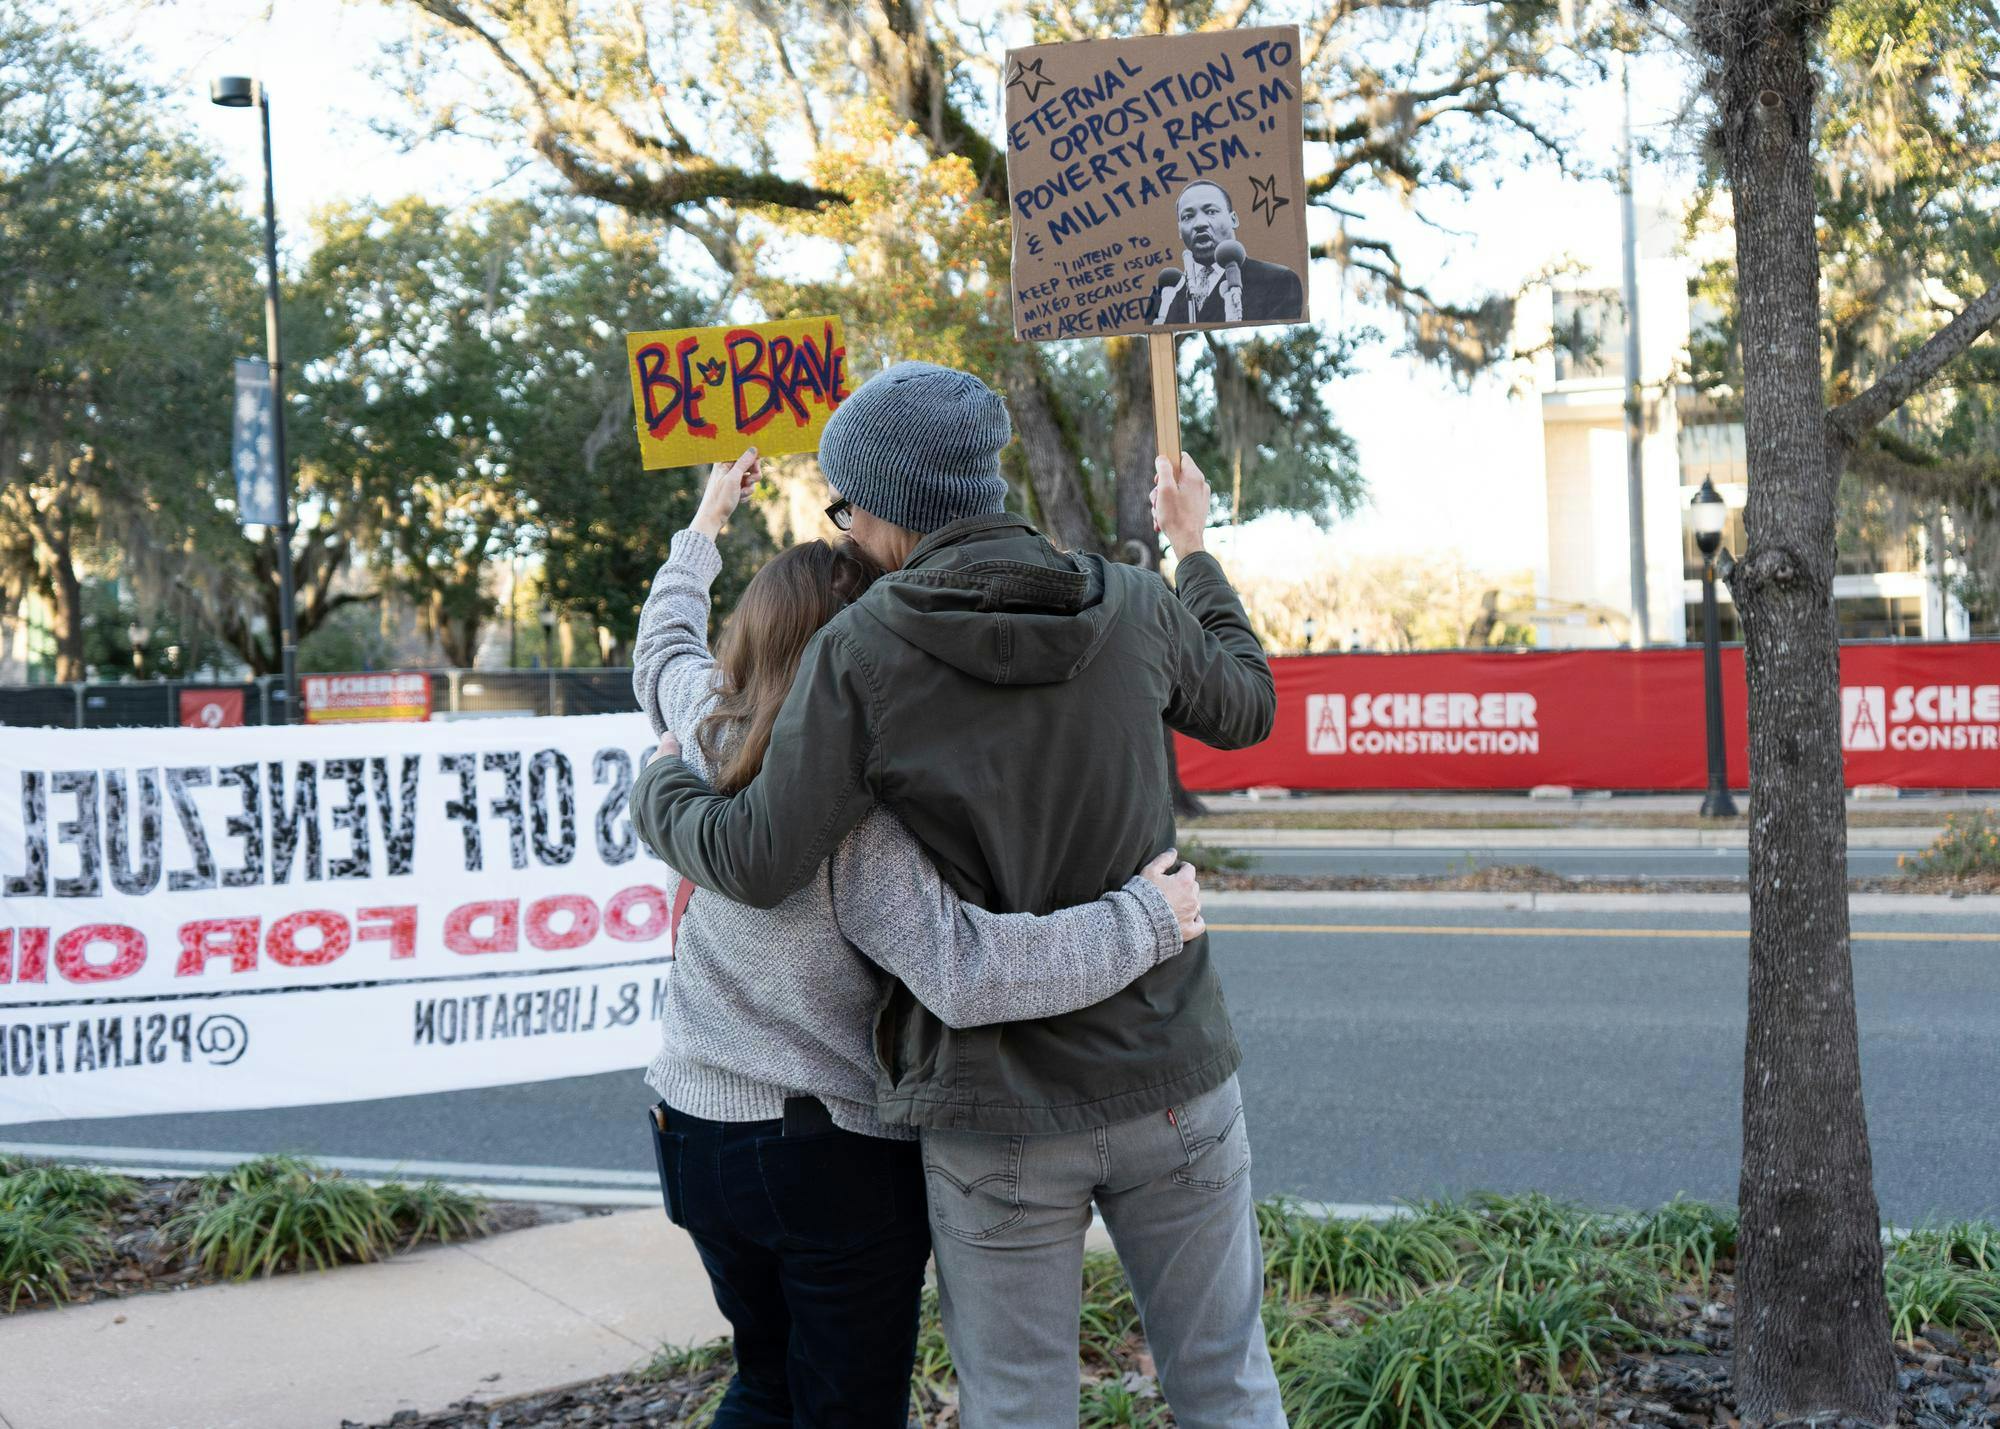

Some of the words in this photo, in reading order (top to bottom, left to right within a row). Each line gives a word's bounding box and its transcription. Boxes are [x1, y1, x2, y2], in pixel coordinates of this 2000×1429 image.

[1050, 53, 1235, 162] OPPOSITION
[1242, 40, 1293, 74] TO
[1163, 77, 1293, 149] RACISM
[1128, 236, 1151, 250] TO
[1018, 278, 1060, 304] KEEP
[1066, 263, 1115, 290] THESE
[1124, 248, 1173, 273] ISSUES
[1024, 297, 1070, 323] MIXED
[1074, 274, 1145, 307] BECAUSE
[1020, 322, 1053, 341] THEY
[1058, 307, 1095, 339] ARE
[636, 336, 718, 440] BE
[724, 321, 851, 435] BRAVE
[1349, 692, 1538, 729] SCHERER
[1889, 685, 2000, 723] SCHE
[1350, 730, 1540, 755] CONSTRUCTION
